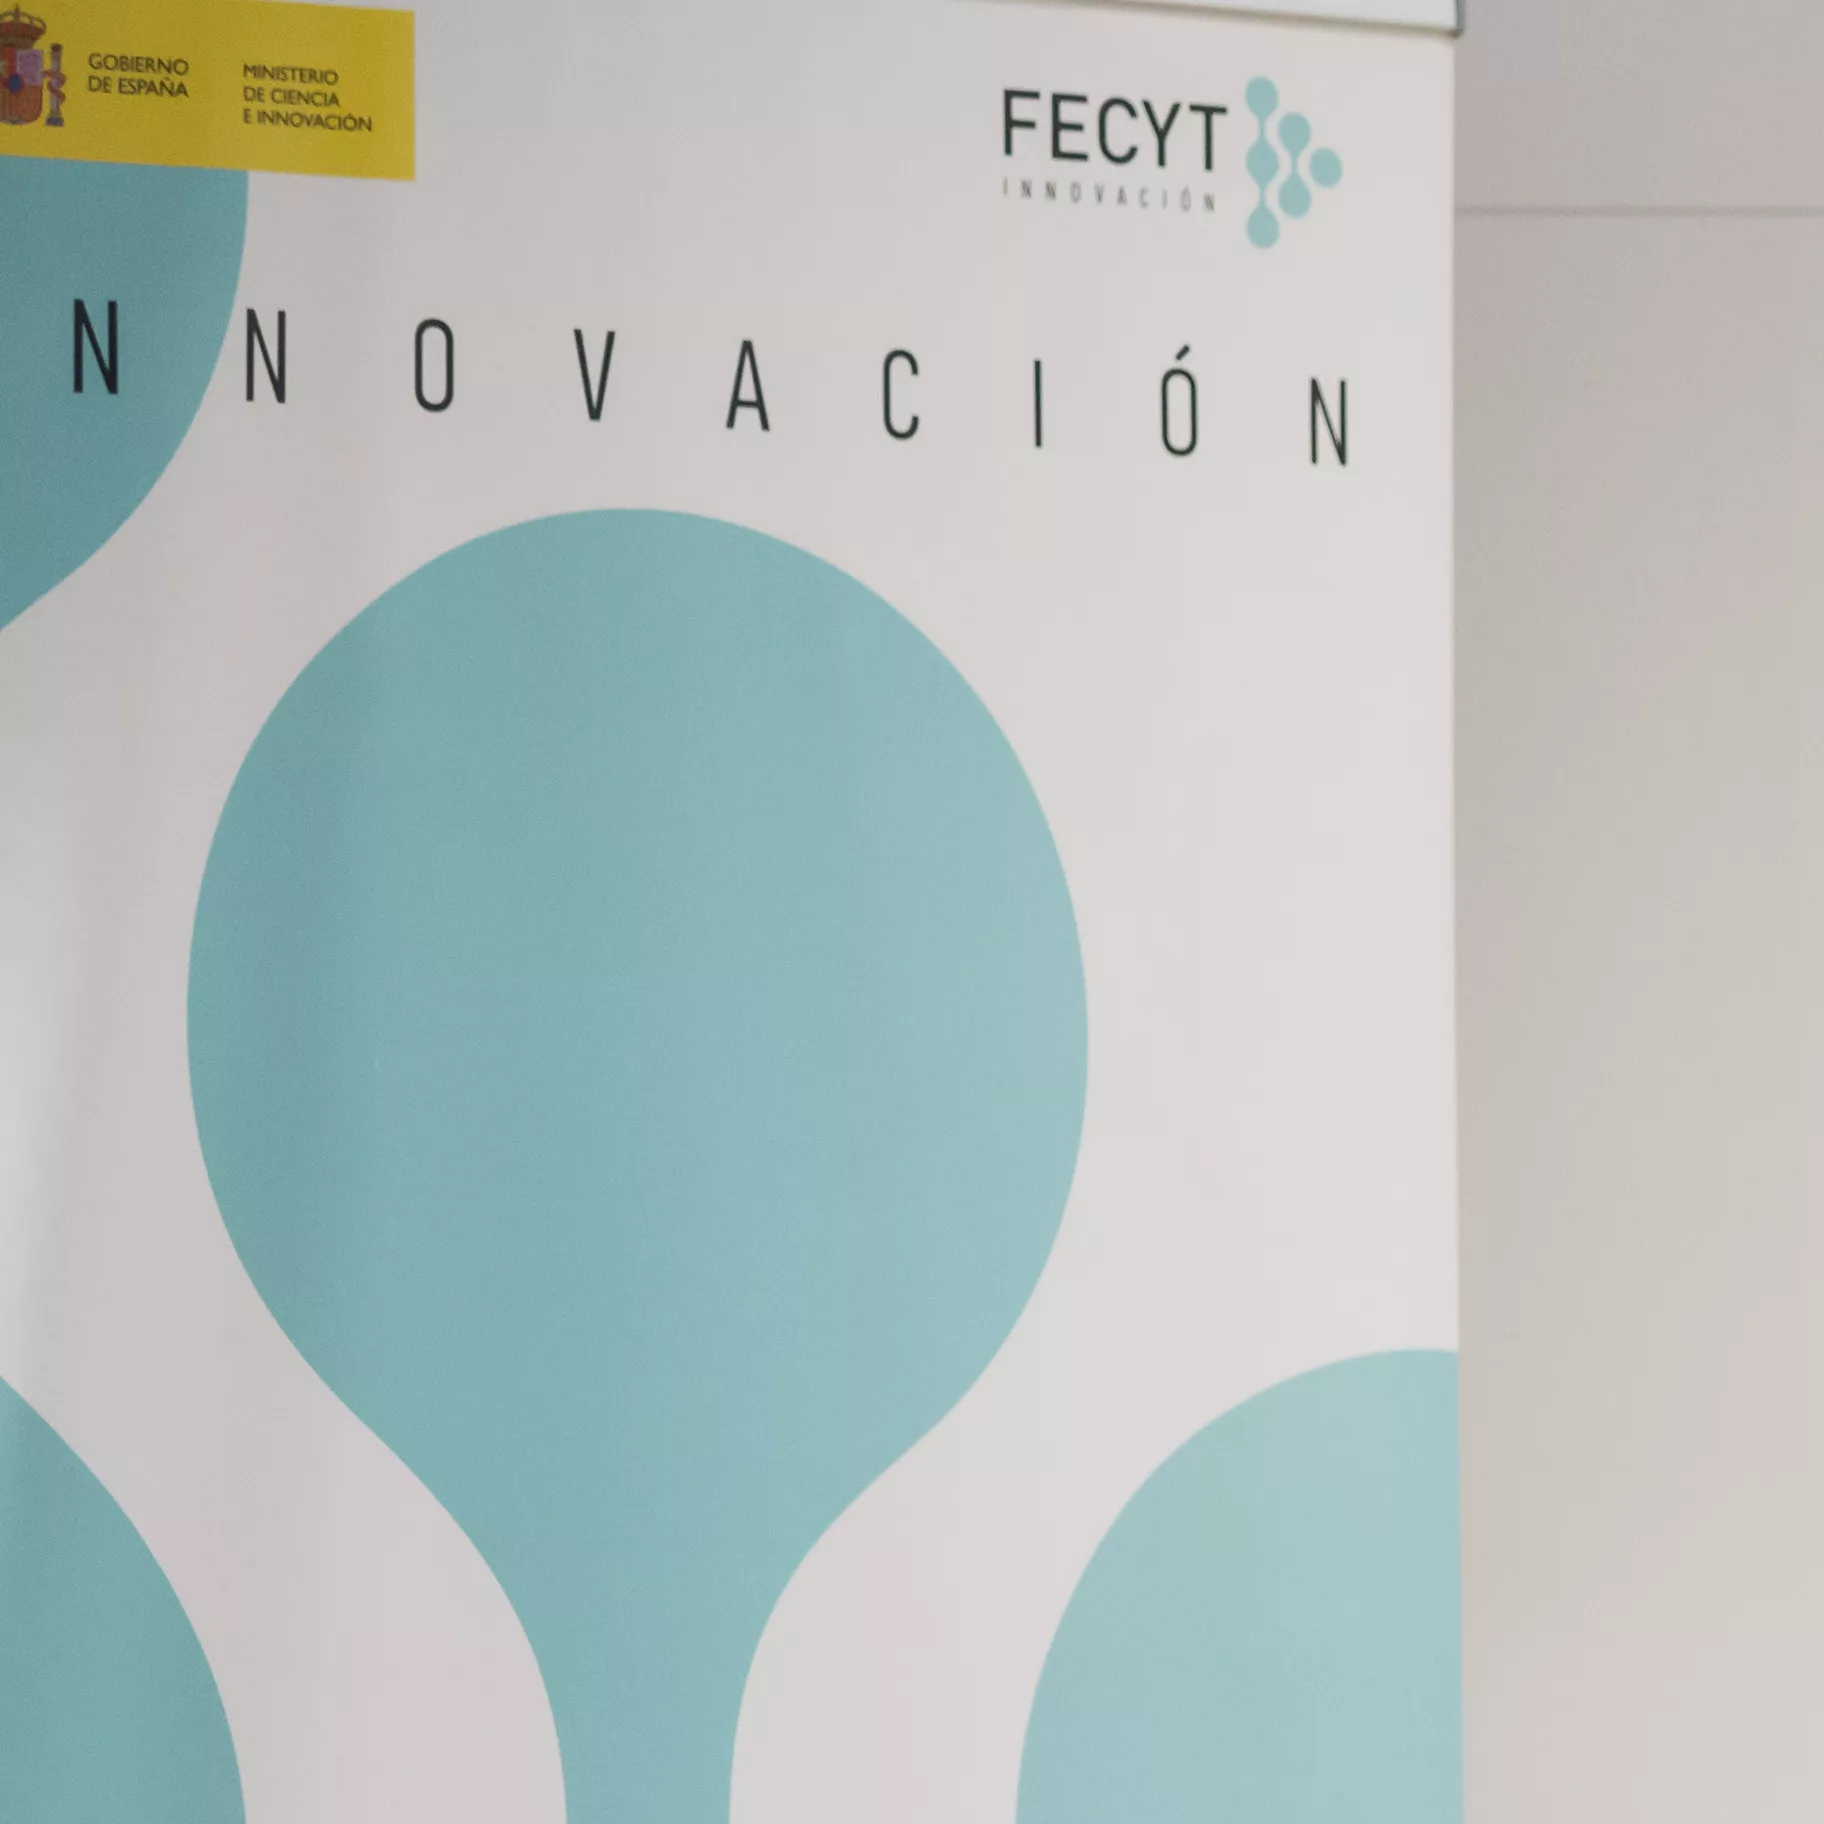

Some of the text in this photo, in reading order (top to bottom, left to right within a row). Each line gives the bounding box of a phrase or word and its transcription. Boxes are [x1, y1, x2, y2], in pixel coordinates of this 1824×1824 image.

[88, 53, 190, 76] GOBIERNO
[243, 64, 339, 86] MINISTERIO
[88, 75, 190, 98] DE ESPAÑA
[243, 86, 340, 107] DE CIENCIA
[243, 108, 373, 131] E INNOVACIÓN
[1003, 88, 1228, 171] FECYT
[1002, 178, 1216, 212] INNOVACIÓN
[73, 298, 1348, 466] NNOVACIÓN
